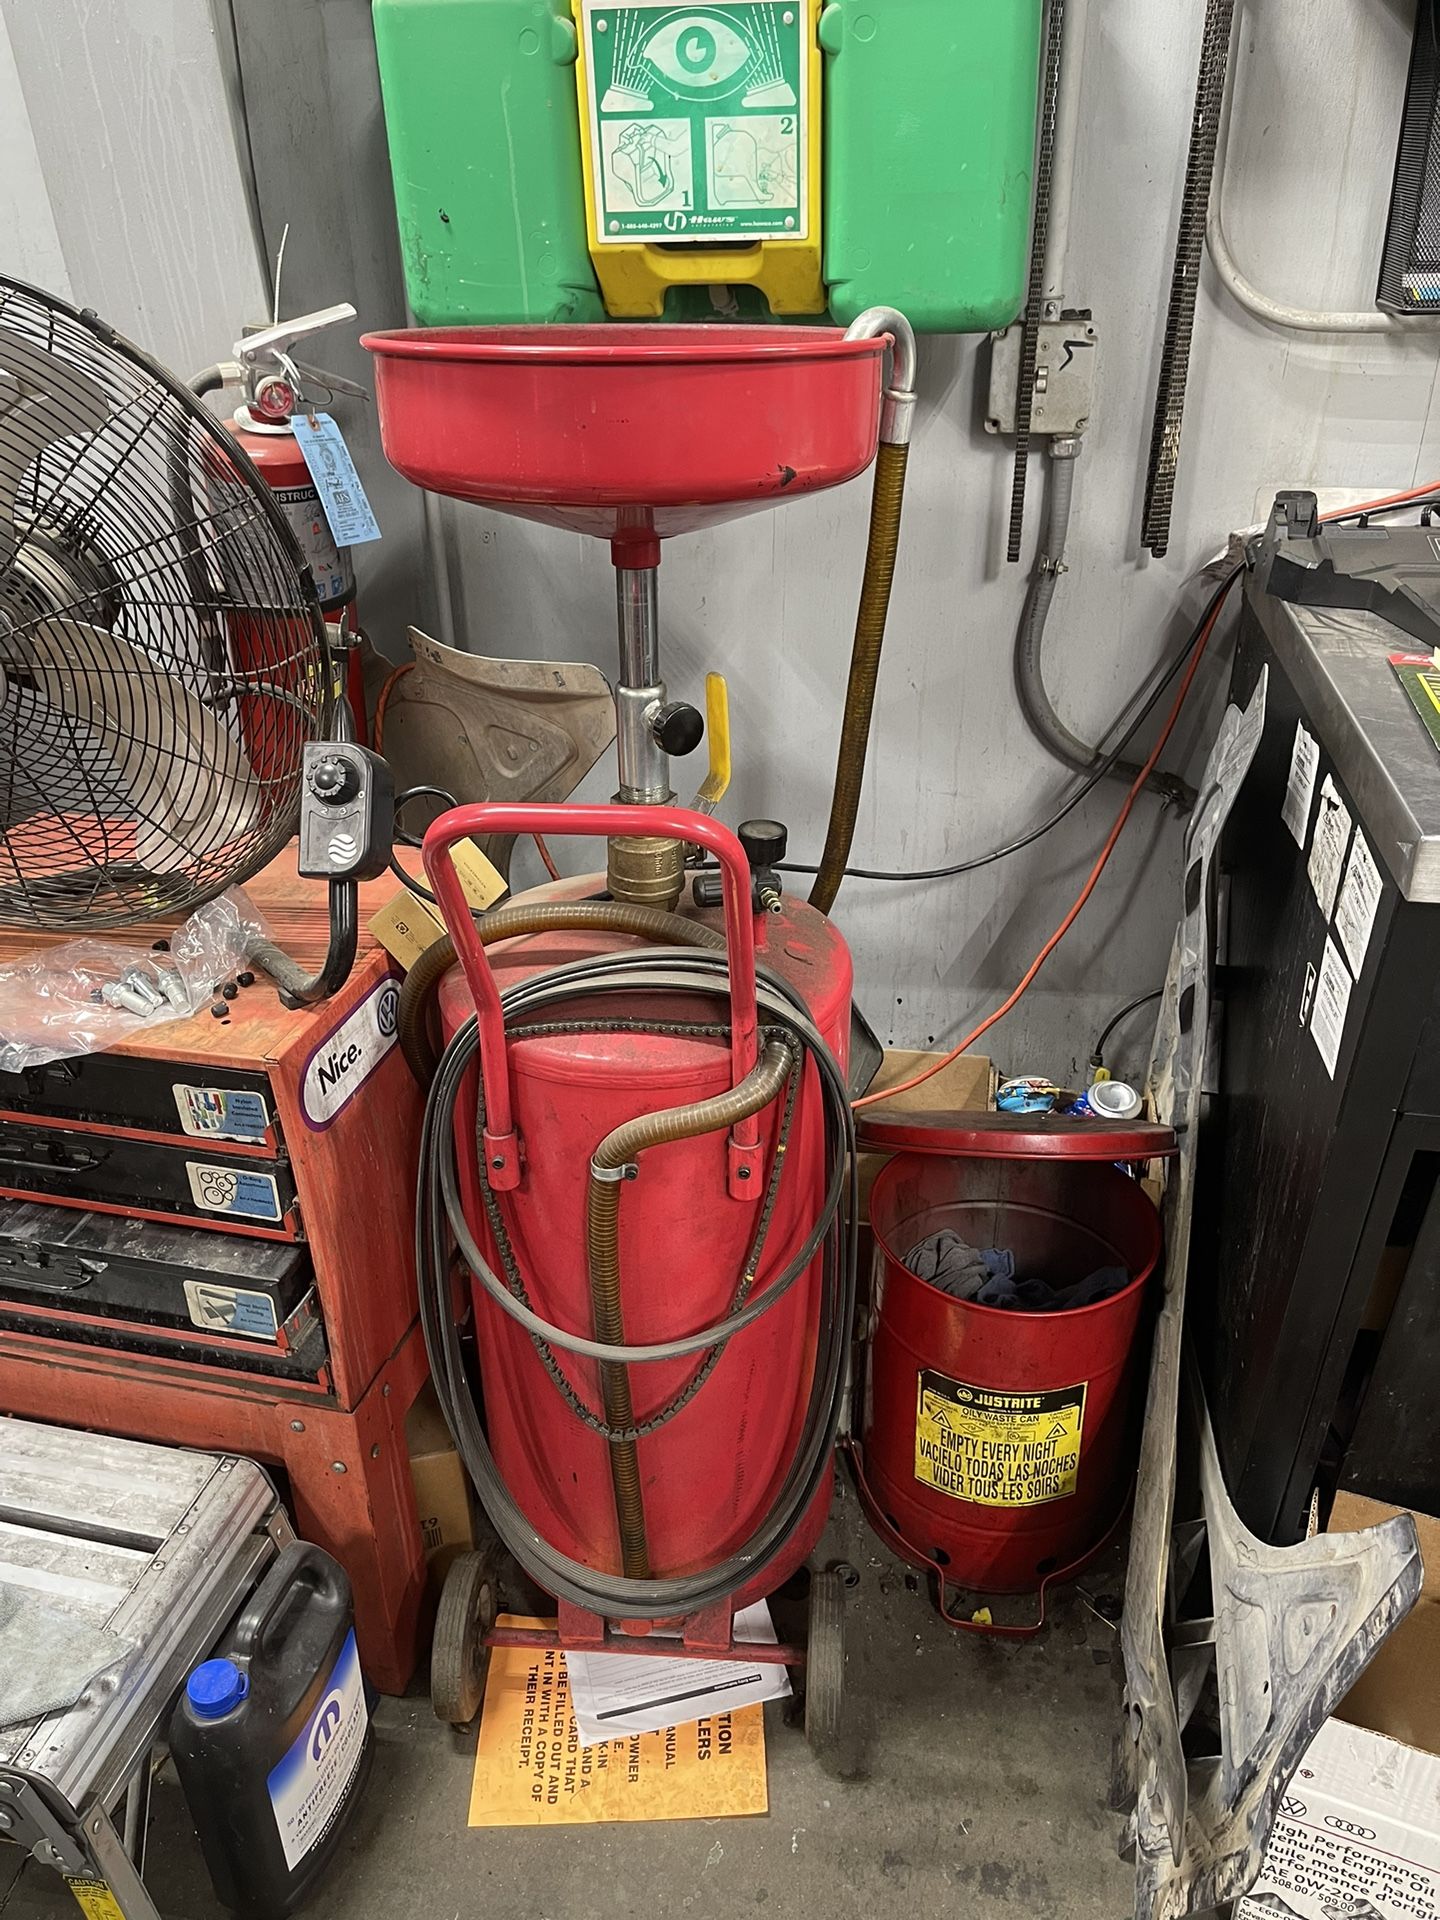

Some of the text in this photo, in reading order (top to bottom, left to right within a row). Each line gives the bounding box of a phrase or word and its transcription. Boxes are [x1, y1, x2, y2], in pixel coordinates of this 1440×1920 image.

[780, 116, 793, 134] 2
[681, 190, 692, 207] 1
[317, 1040, 363, 1096] Nice.
[962, 1407, 983, 1420] OILY
[984, 1411, 1017, 1423] WASTE
[1019, 1415, 1040, 1423] CAN
[974, 1393, 1042, 1409] JUSTRITE
[919, 1436, 1077, 1483] VACIELO TODAS LAS NOCHES
[940, 1428, 1058, 1462] EMPTY EVERY NIGHT
[933, 1464, 1060, 1500] VIDER TOUS LES SOIRS
[543, 1671, 553, 1685] IN
[557, 1671, 568, 1688] BE
[518, 1664, 539, 1769] THEIR RECEIPT.
[539, 1689, 552, 1723] WITH
[552, 1692, 566, 1737] FILLED
[537, 1727, 548, 1737] A
[718, 1712, 732, 1754] TION
[533, 1740, 547, 1779] COPY
[550, 1741, 562, 1770] OUT
[580, 1746, 593, 1788] AND A
[628, 1734, 640, 1783] OWNER
[297, 1760, 338, 1827] ANTIFREEZE
[531, 1783, 543, 1802] OF
[547, 1775, 559, 1805] AND
[564, 1758, 577, 1794] THAT
[1265, 1852, 1371, 1896] erformance
[1314, 1835, 1431, 1885] Performance
[1342, 1856, 1404, 1885] Engine
[1410, 1881, 1436, 1898] Oil
[68, 1878, 105, 1890] CAUTION
[1262, 1863, 1355, 1903] AE 0W-20
[1272, 1876, 1309, 1896] 508.00
[1318, 1893, 1355, 1913] 509.00
[1311, 1858, 1378, 1887] moteur
[1383, 1883, 1435, 1910] haute
